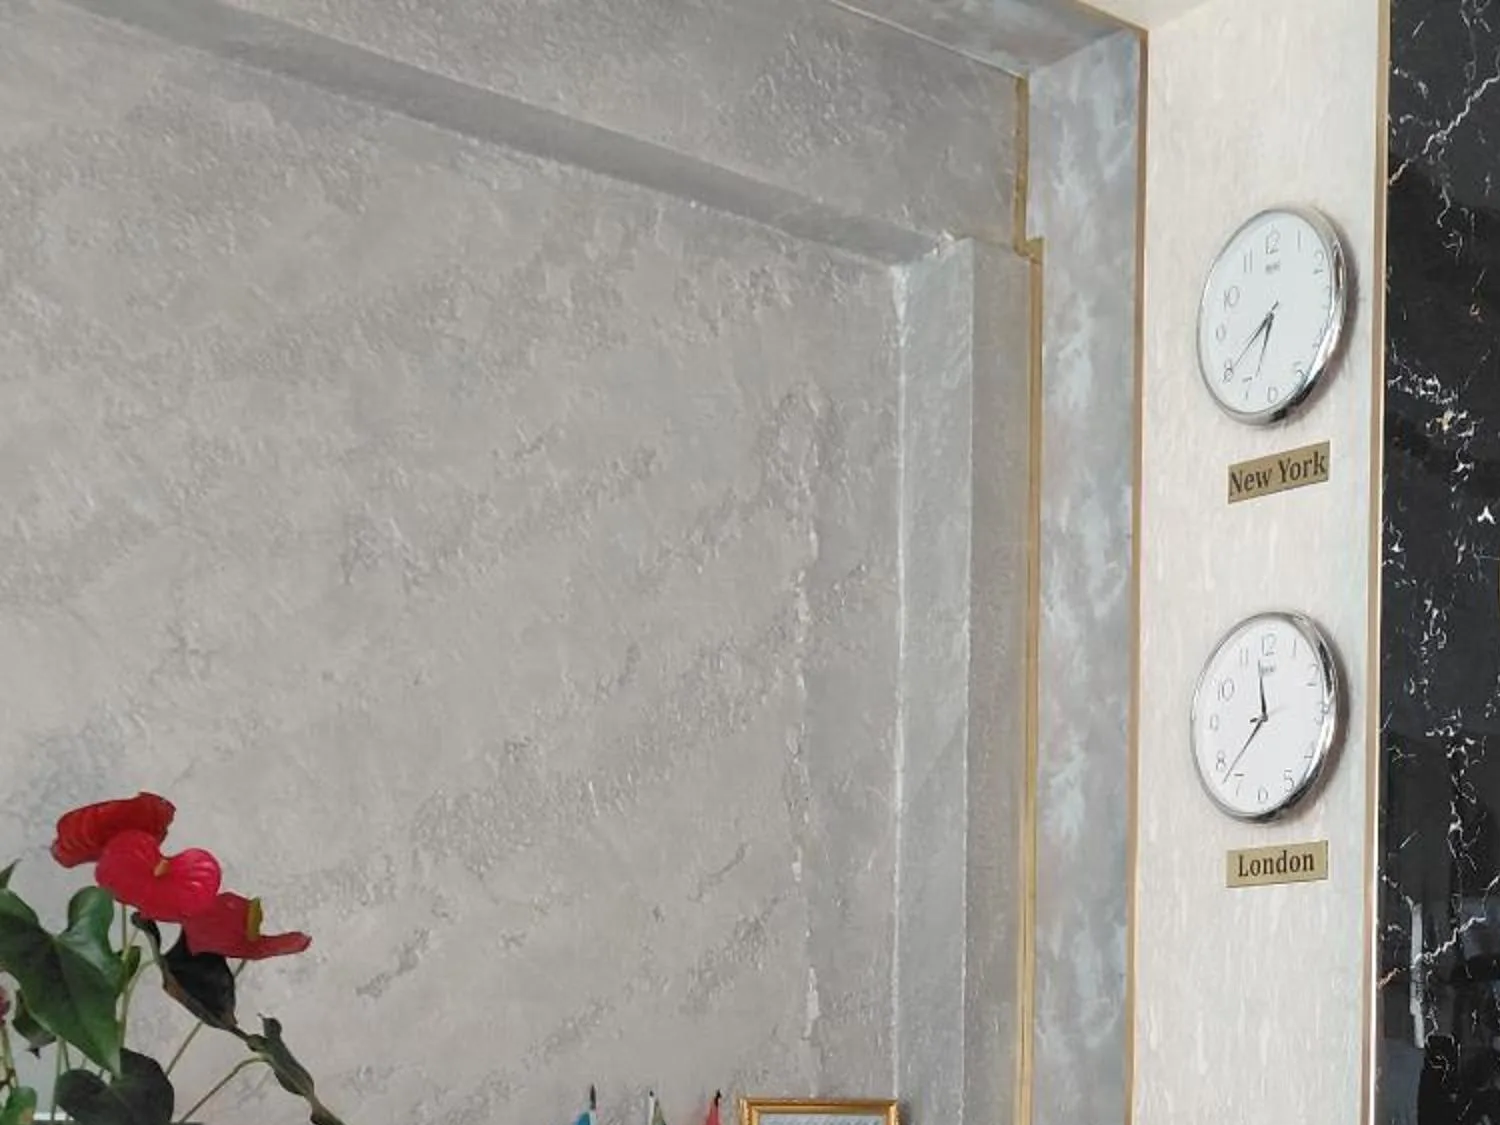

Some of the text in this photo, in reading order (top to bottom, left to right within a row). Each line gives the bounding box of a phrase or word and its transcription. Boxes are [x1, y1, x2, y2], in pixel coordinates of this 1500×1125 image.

[1230, 451, 1326, 496] New York
[1238, 849, 1314, 877] London
